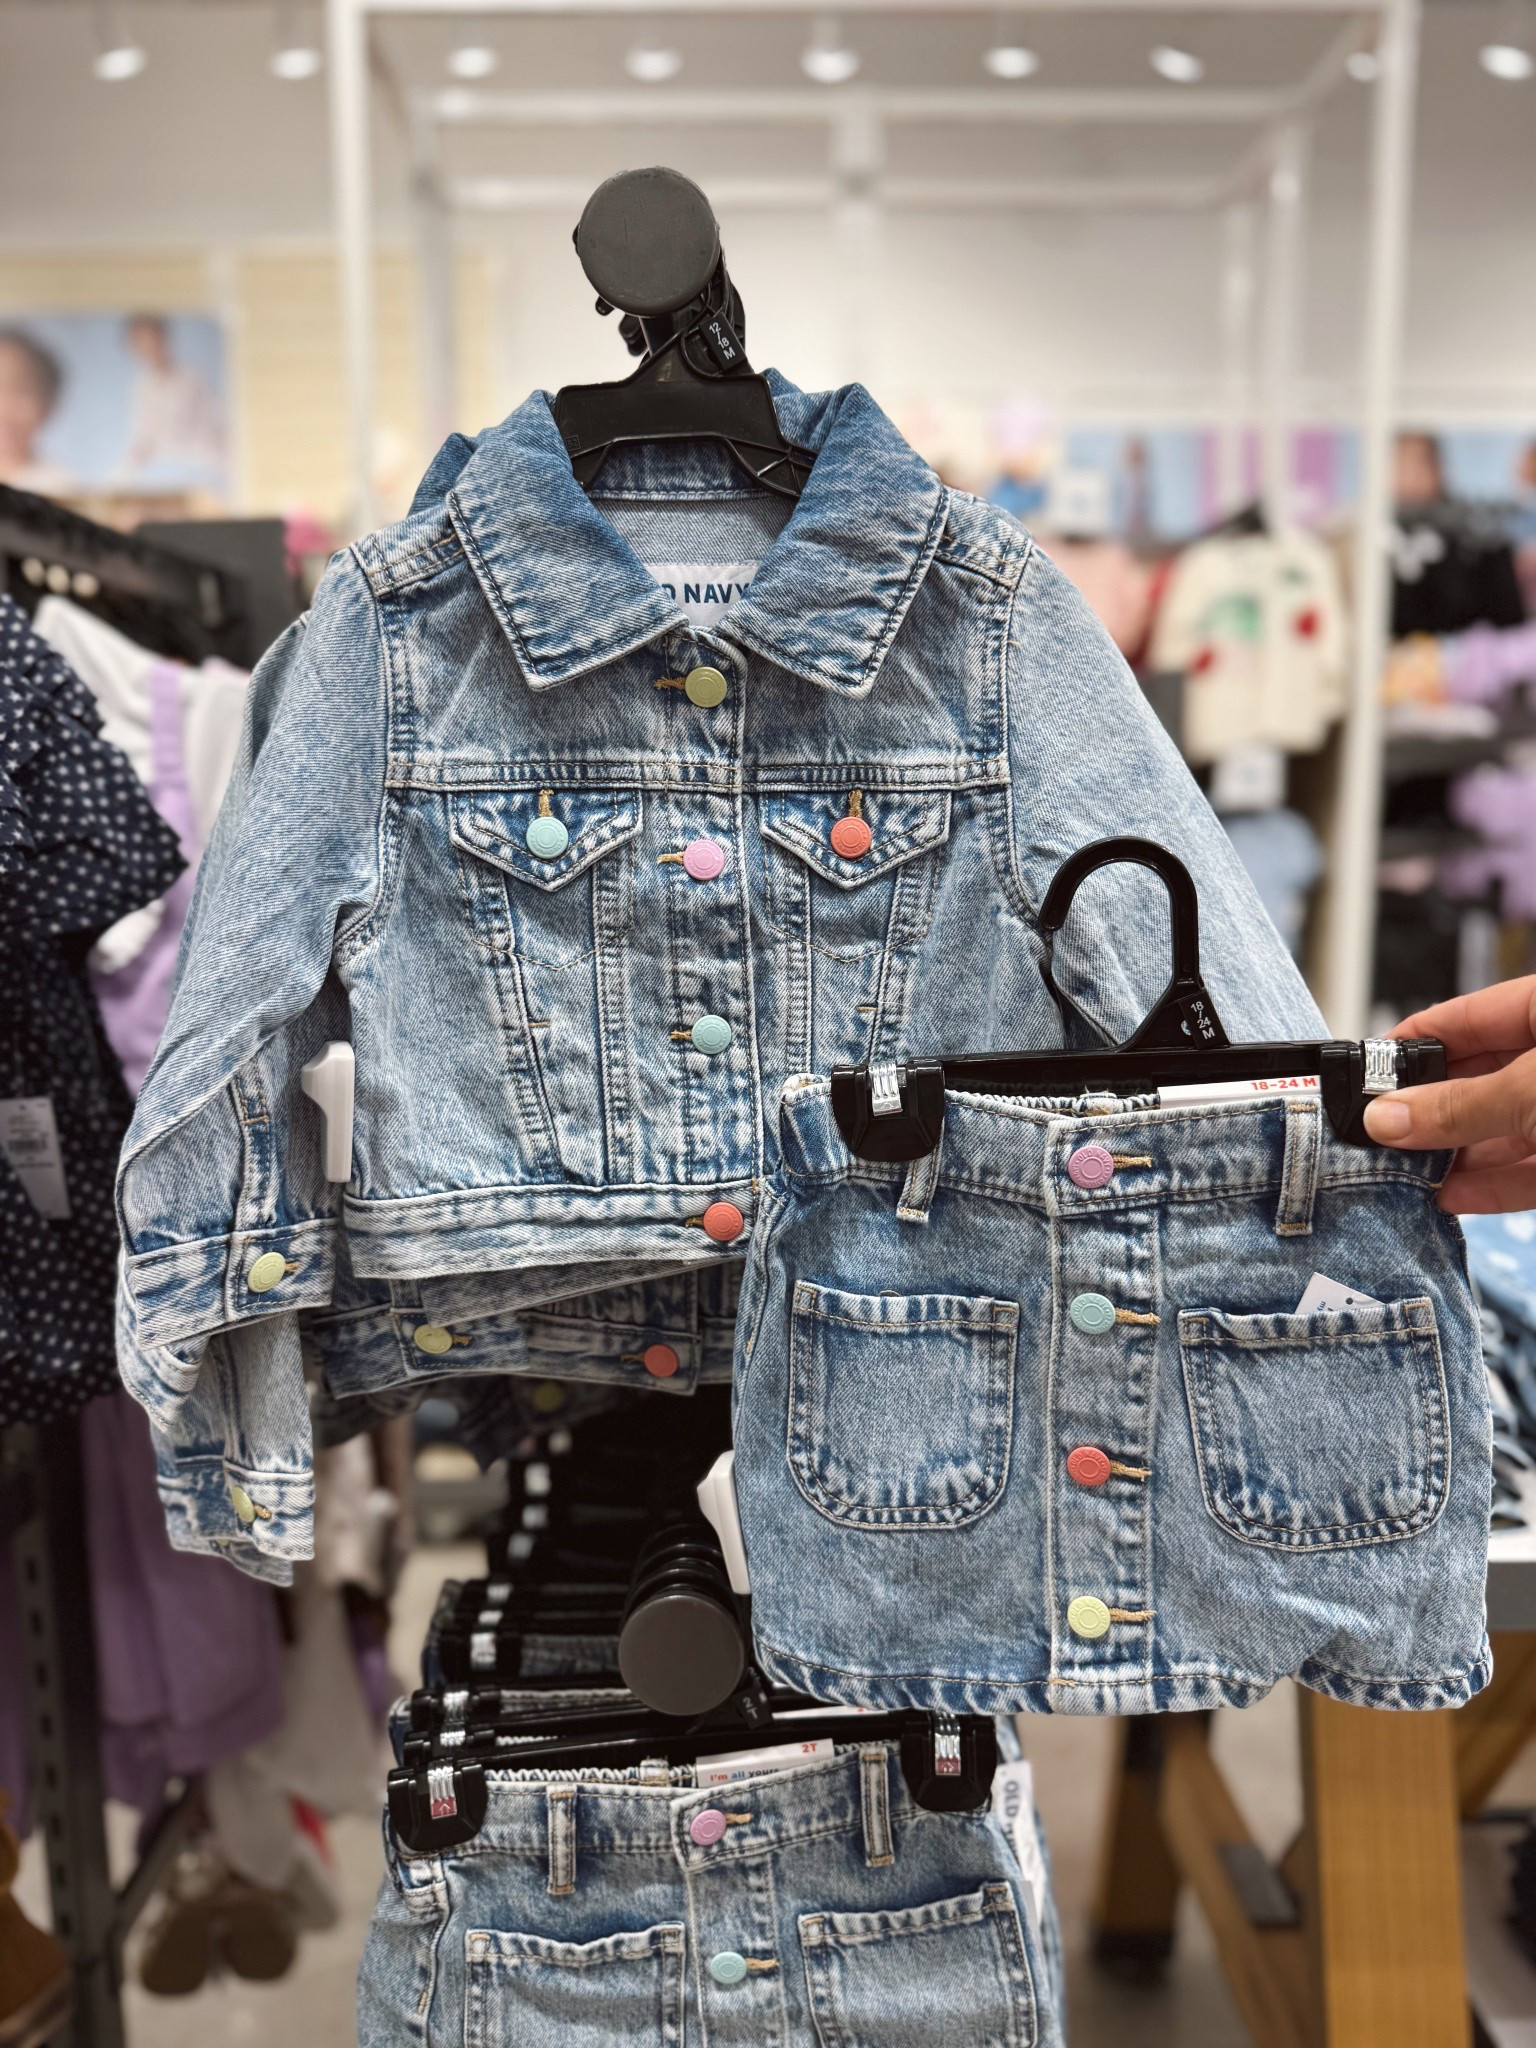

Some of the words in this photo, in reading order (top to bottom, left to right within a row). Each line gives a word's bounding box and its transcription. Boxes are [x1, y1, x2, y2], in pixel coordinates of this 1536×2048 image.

[684, 583, 750, 604] NAVY
[1251, 1079, 1299, 1090] 18-24
[1302, 1077, 1317, 1087] M
[801, 1743, 818, 1753] 2T
[731, 1770, 745, 1779] all
[1004, 1780, 1020, 1818] OLD
